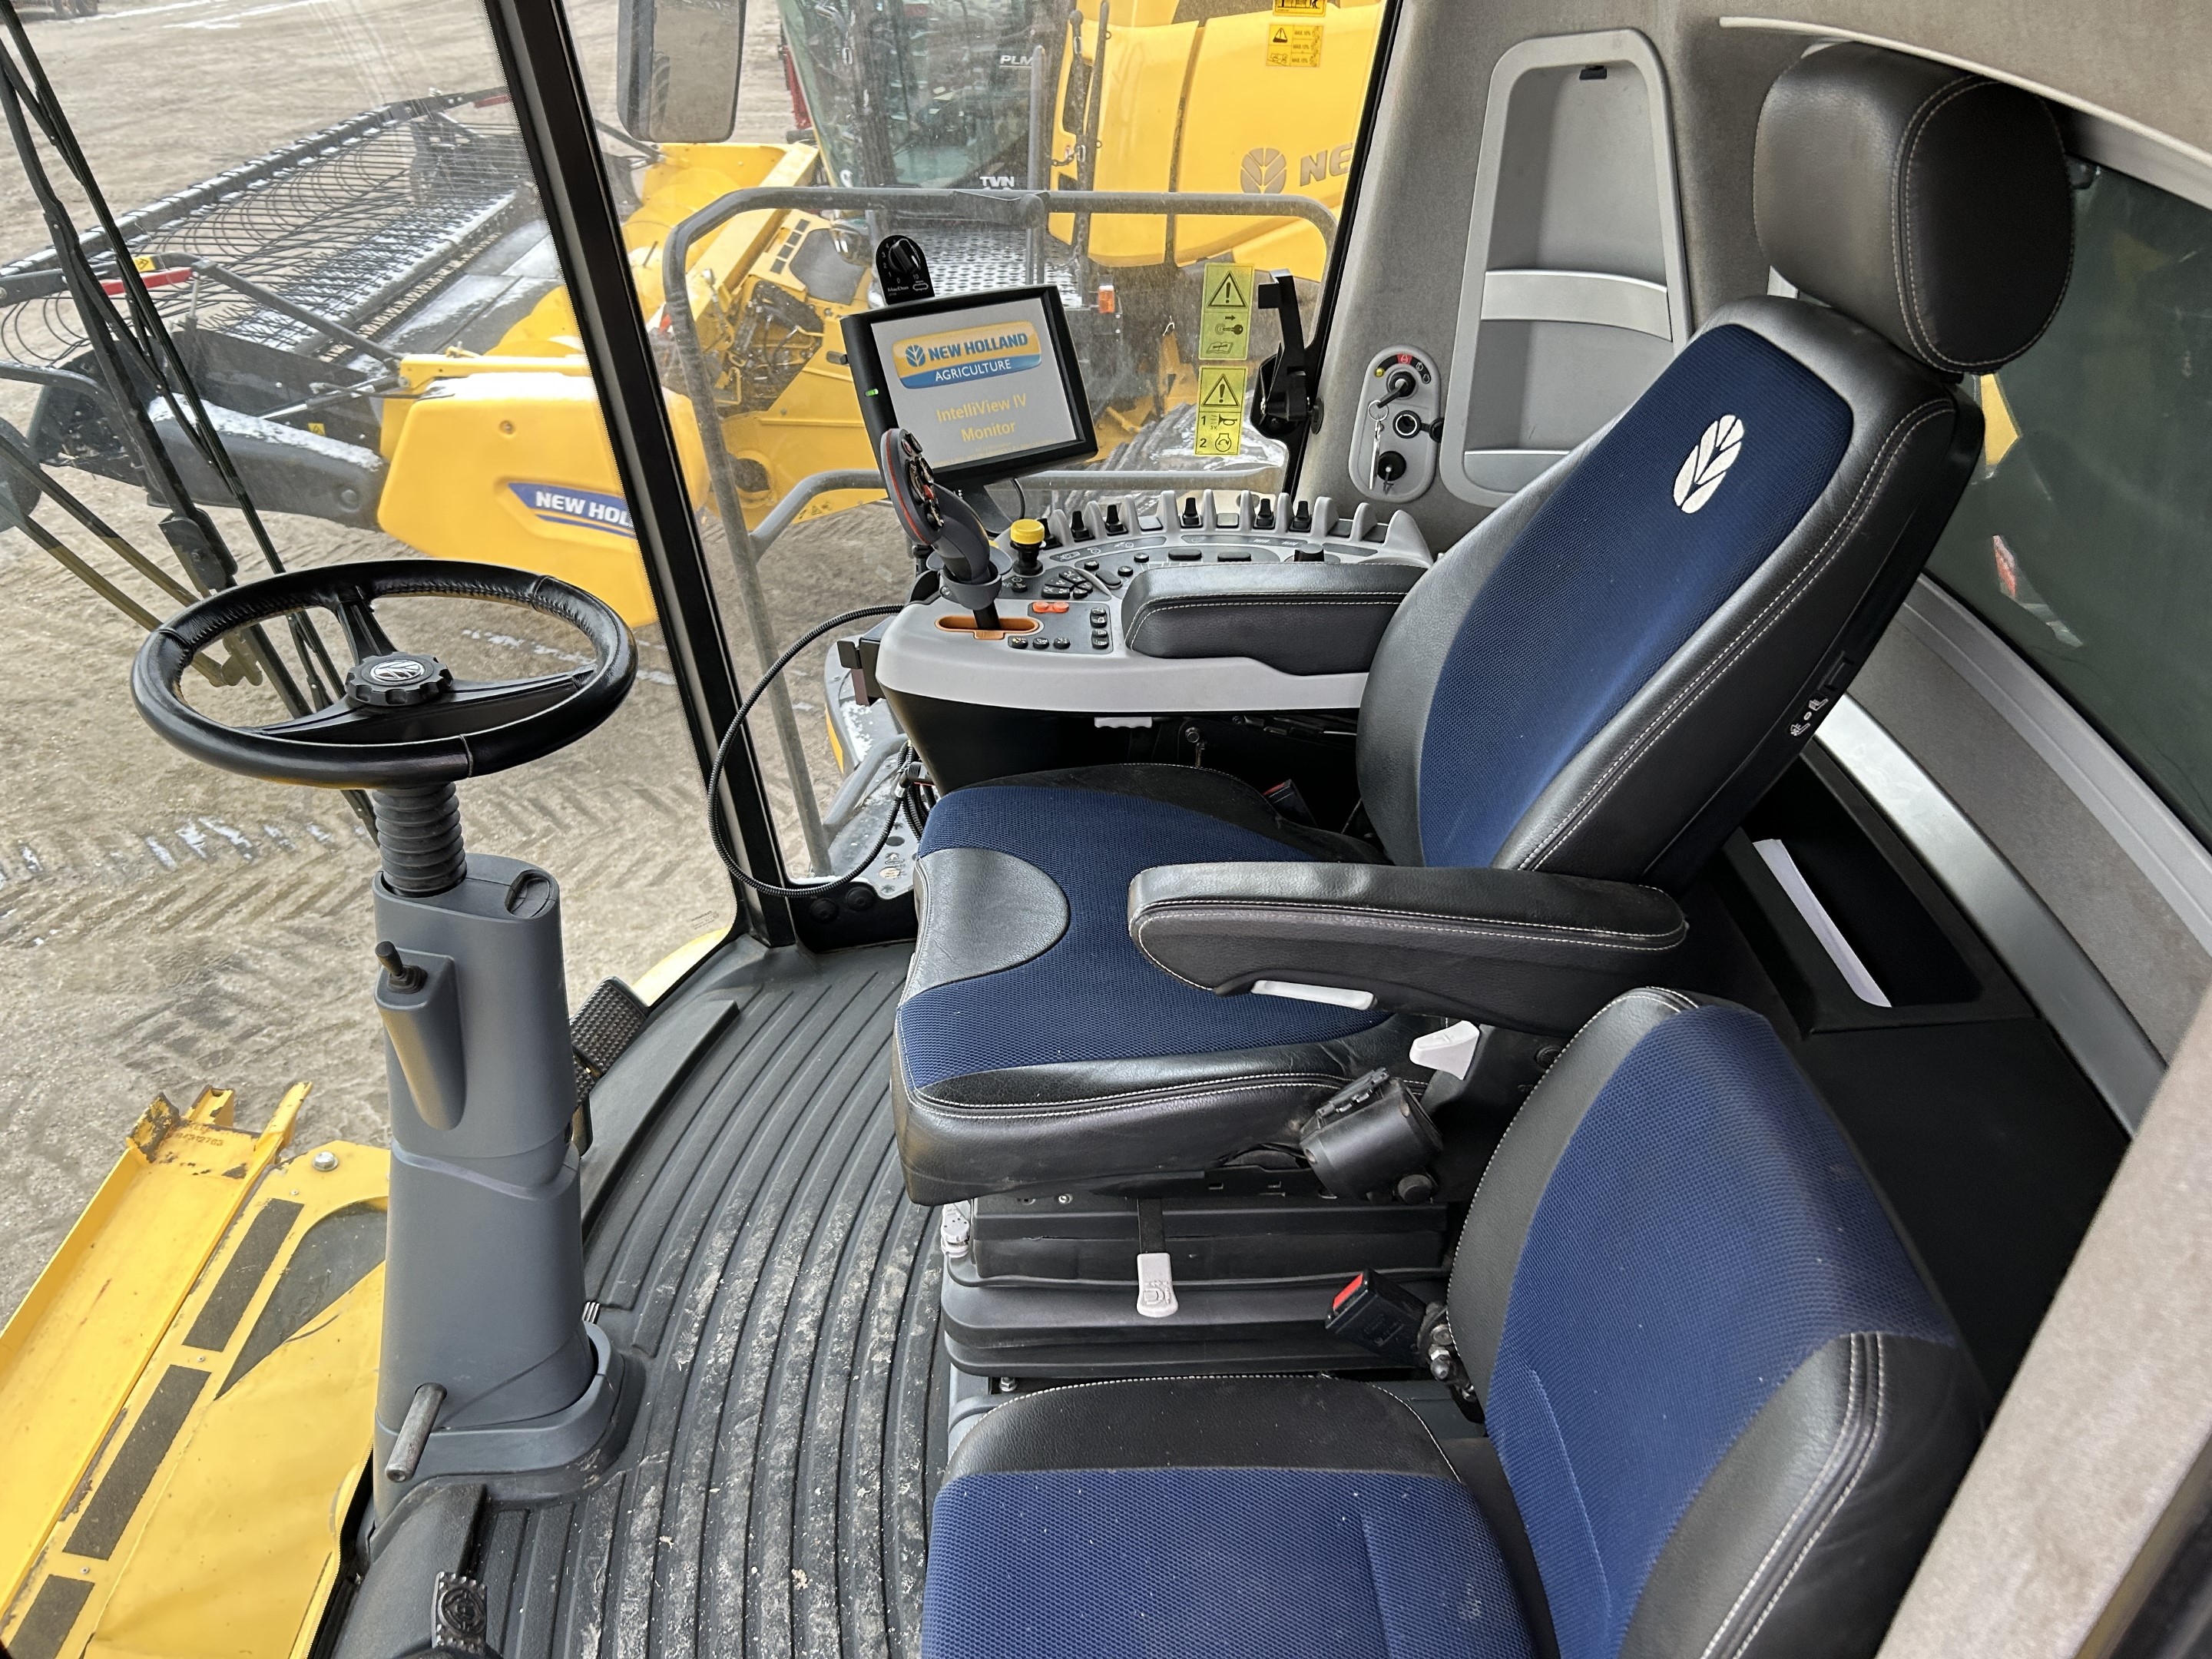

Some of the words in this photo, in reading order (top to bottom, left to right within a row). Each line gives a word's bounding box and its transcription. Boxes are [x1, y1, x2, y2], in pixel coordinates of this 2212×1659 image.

[928, 343, 962, 361] NEW
[963, 333, 1028, 356] HOLLAND
[935, 359, 1012, 382] AGRICULTURE
[936, 397, 1010, 423] IntelliView
[1012, 392, 1027, 409] IV
[961, 422, 1016, 442] Monitor
[1200, 415, 1207, 426] 1
[1199, 438, 1207, 448] 2
[535, 490, 586, 515] NEW
[588, 502, 634, 528] HOL
